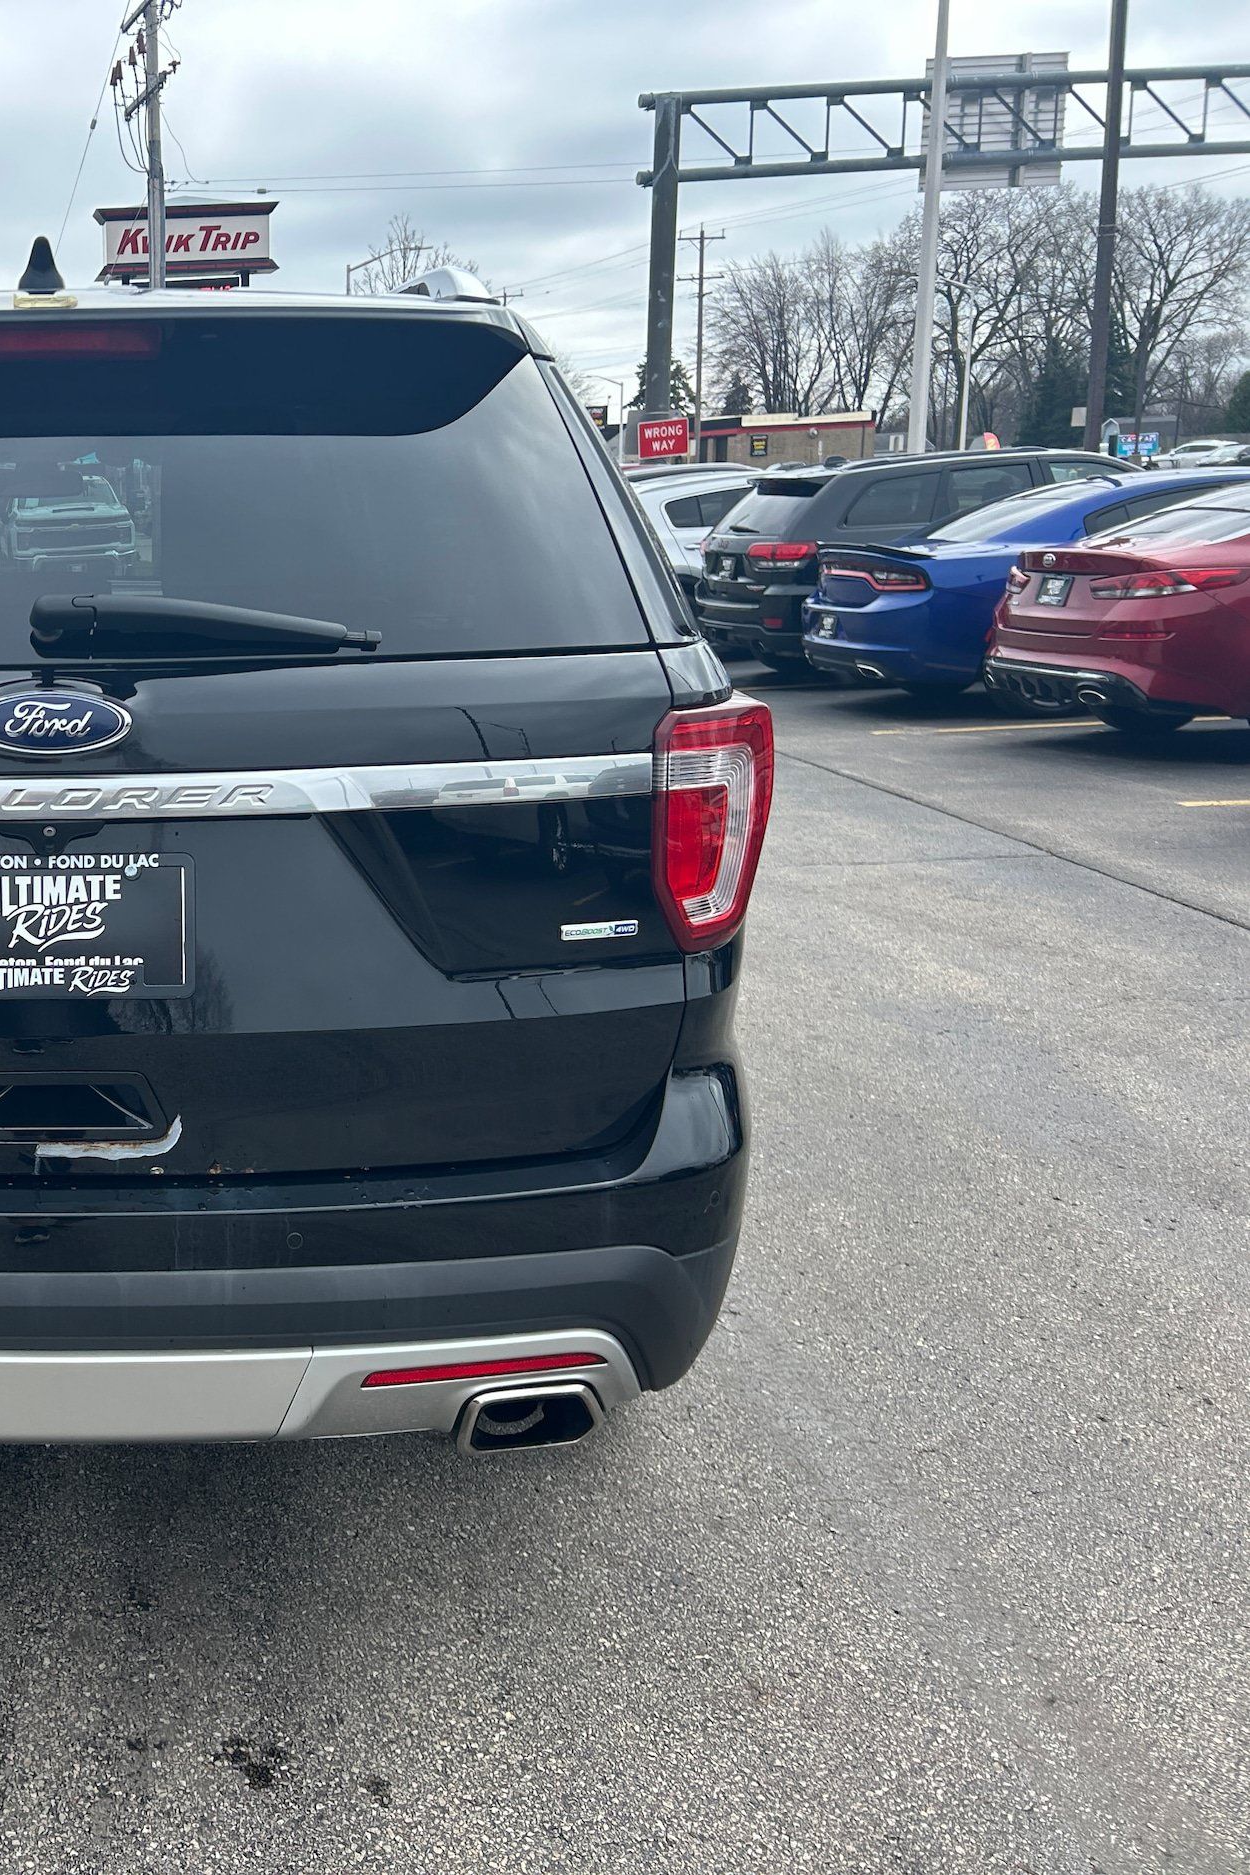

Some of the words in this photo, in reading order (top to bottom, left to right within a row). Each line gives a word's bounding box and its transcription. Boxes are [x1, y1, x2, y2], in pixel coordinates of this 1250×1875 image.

[197, 225, 260, 252] TRIP
[644, 424, 683, 439] WRONG
[652, 439, 676, 452] WAY
[4, 700, 93, 739] Ford
[48, 854, 95, 869] FOND
[100, 854, 124, 868] DU
[128, 853, 159, 869] LAC
[615, 925, 635, 933] 4WD
